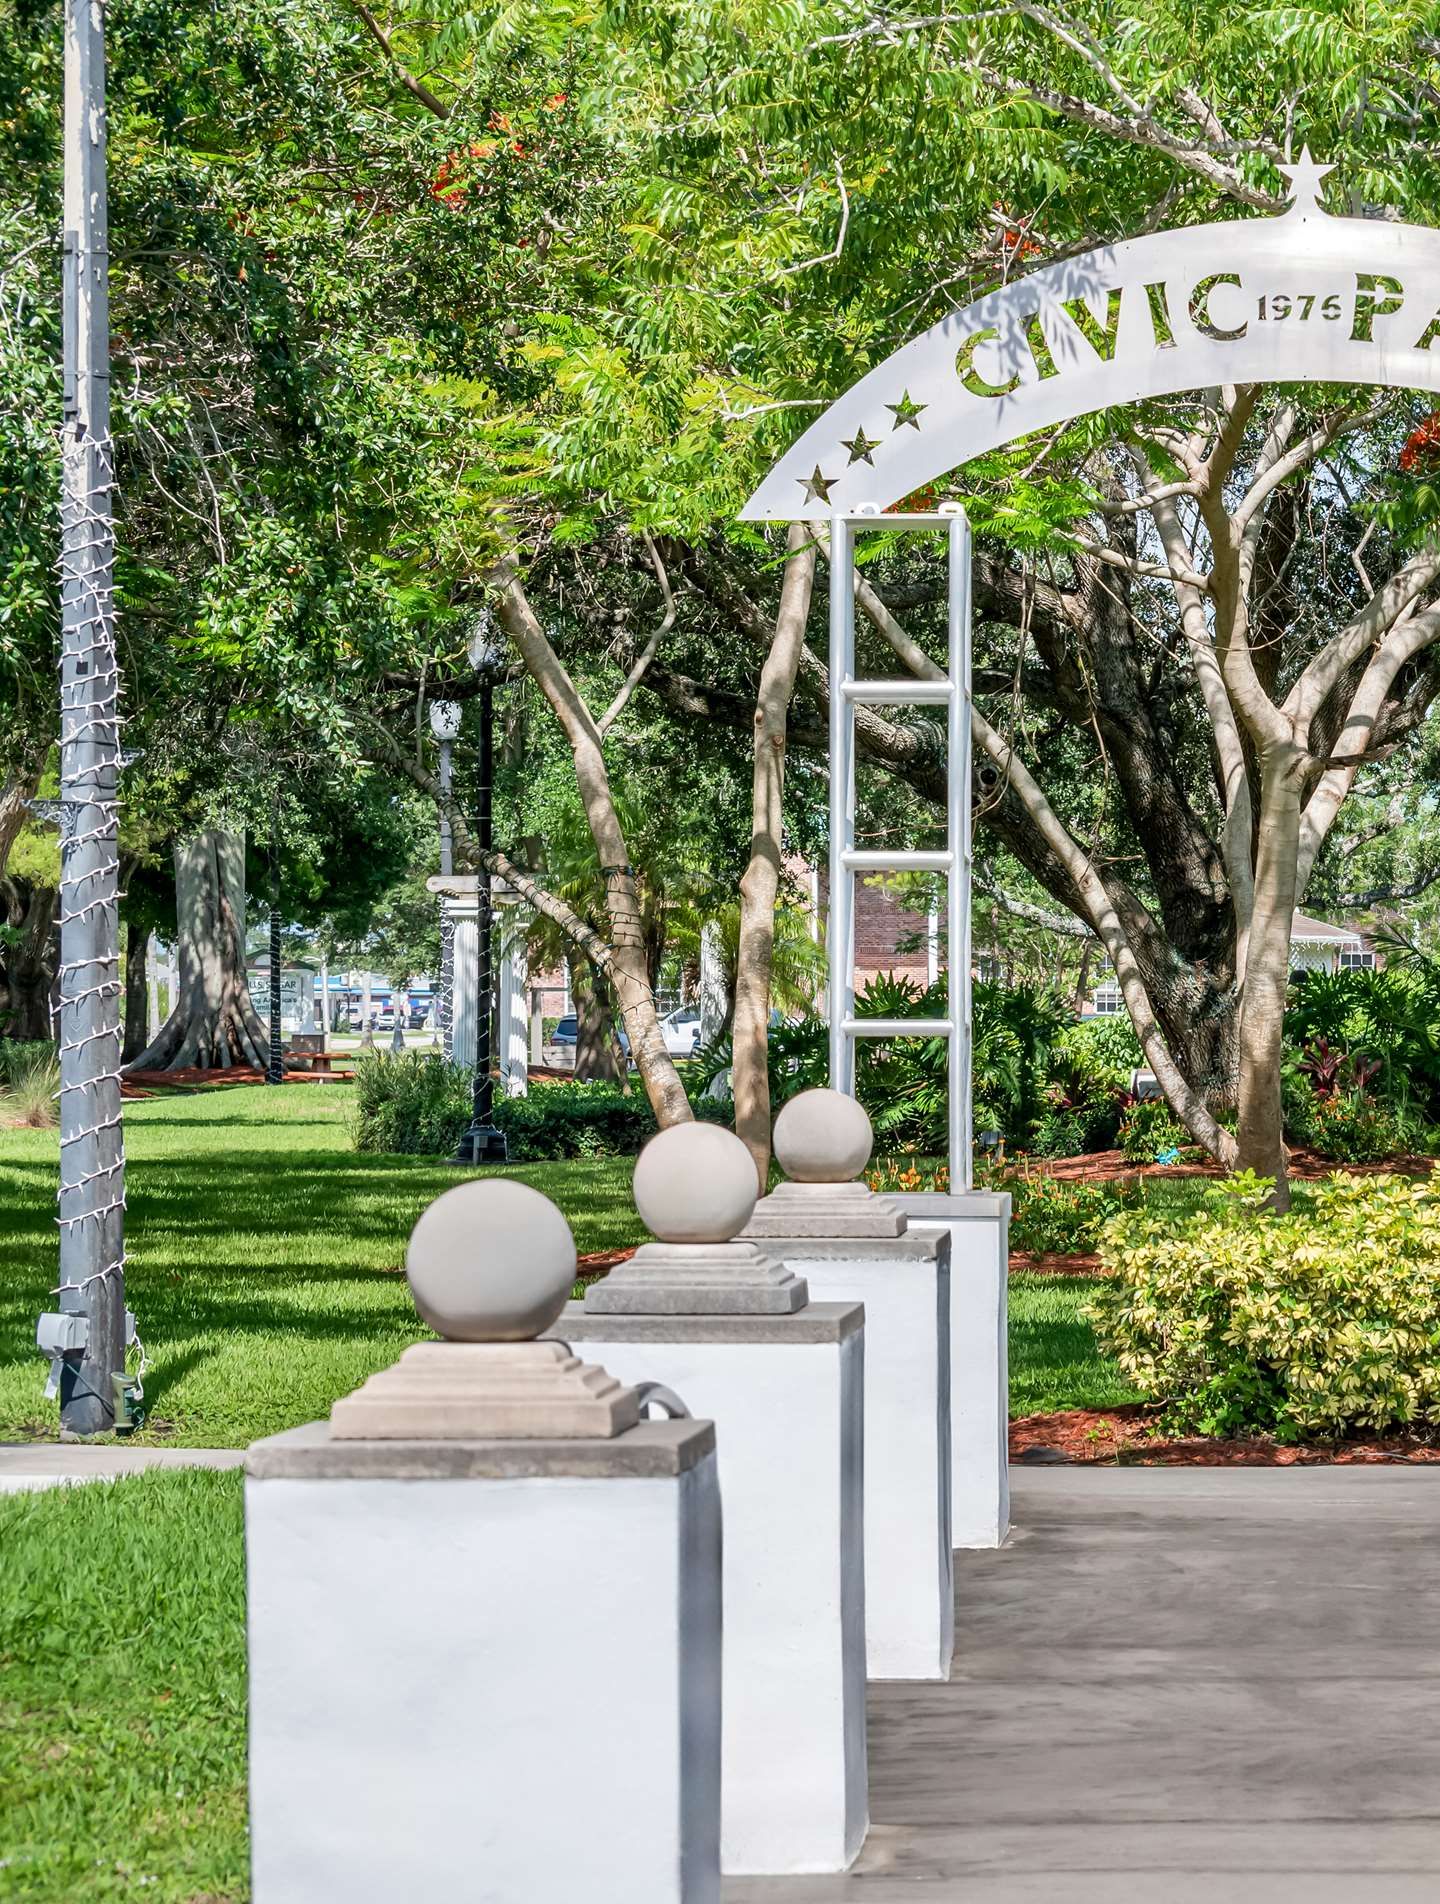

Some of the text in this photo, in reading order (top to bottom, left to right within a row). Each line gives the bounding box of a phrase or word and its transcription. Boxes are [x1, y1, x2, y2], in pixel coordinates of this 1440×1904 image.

[955, 273, 1249, 398] CIVIC
[1256, 295, 1342, 321] 1976
[265, 980, 296, 989] SAR
